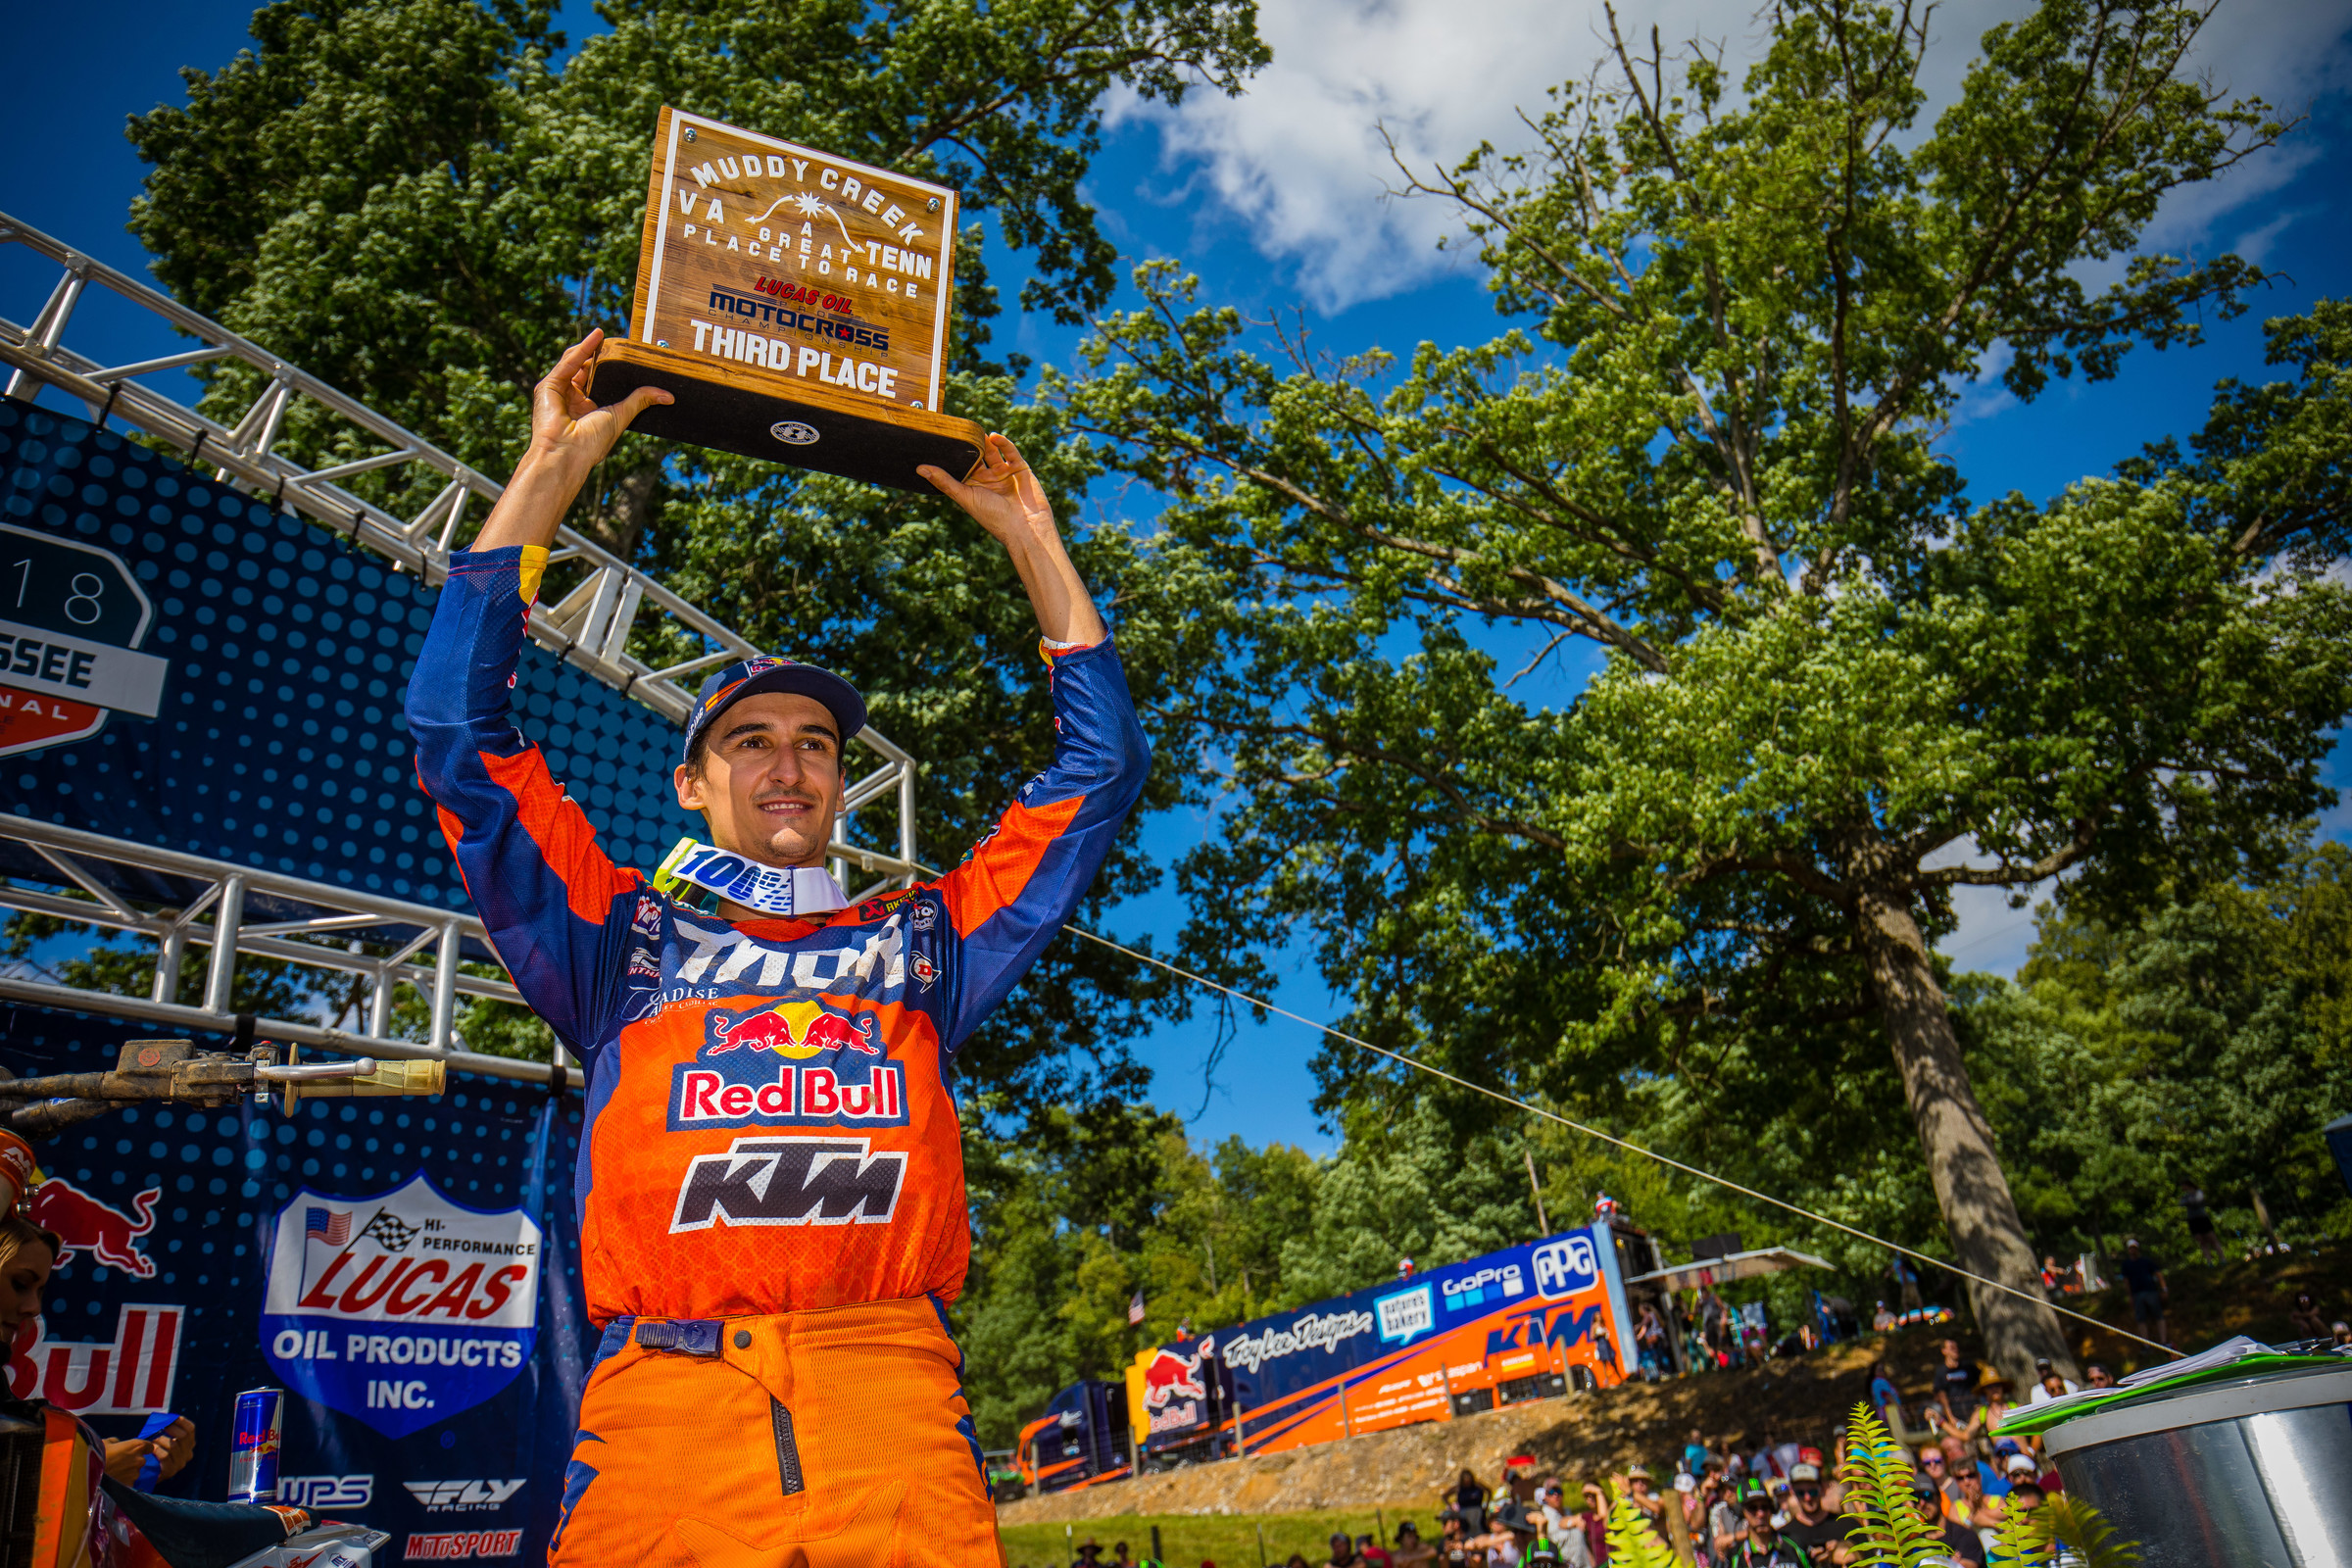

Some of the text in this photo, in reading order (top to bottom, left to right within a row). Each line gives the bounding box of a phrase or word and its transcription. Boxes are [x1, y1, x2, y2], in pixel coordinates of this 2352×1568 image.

[690, 154, 924, 245] MUDDY CREEK
[759, 226, 852, 266] GREAT
[801, 221, 812, 236] A
[683, 223, 918, 300] PLACE TO RACE
[864, 240, 932, 280] TENN
[754, 276, 855, 315] LUCAS OIL
[779, 300, 826, 318] PRO
[708, 309, 889, 359] CHAMPIONSHIP
[710, 290, 890, 352] MOTOCROSS
[690, 319, 899, 399] THIRD PLACE
[682, 1066, 900, 1119] Red Bull
[671, 1138, 907, 1233] KTM
[422, 1237, 536, 1256] PERFORMANCE
[1539, 1243, 1592, 1288] PPG
[298, 1252, 527, 1320] LUCAS
[1442, 1263, 1521, 1296] GoPro
[1386, 1310, 1427, 1332] bakery
[1484, 1299, 1601, 1366] KTM
[273, 1329, 522, 1368] OIL PRODUCTS
[367, 1380, 434, 1409] INC.
[239, 1429, 267, 1445] Red
[403, 1479, 527, 1504] FLY
[426, 1503, 501, 1512] RACING
